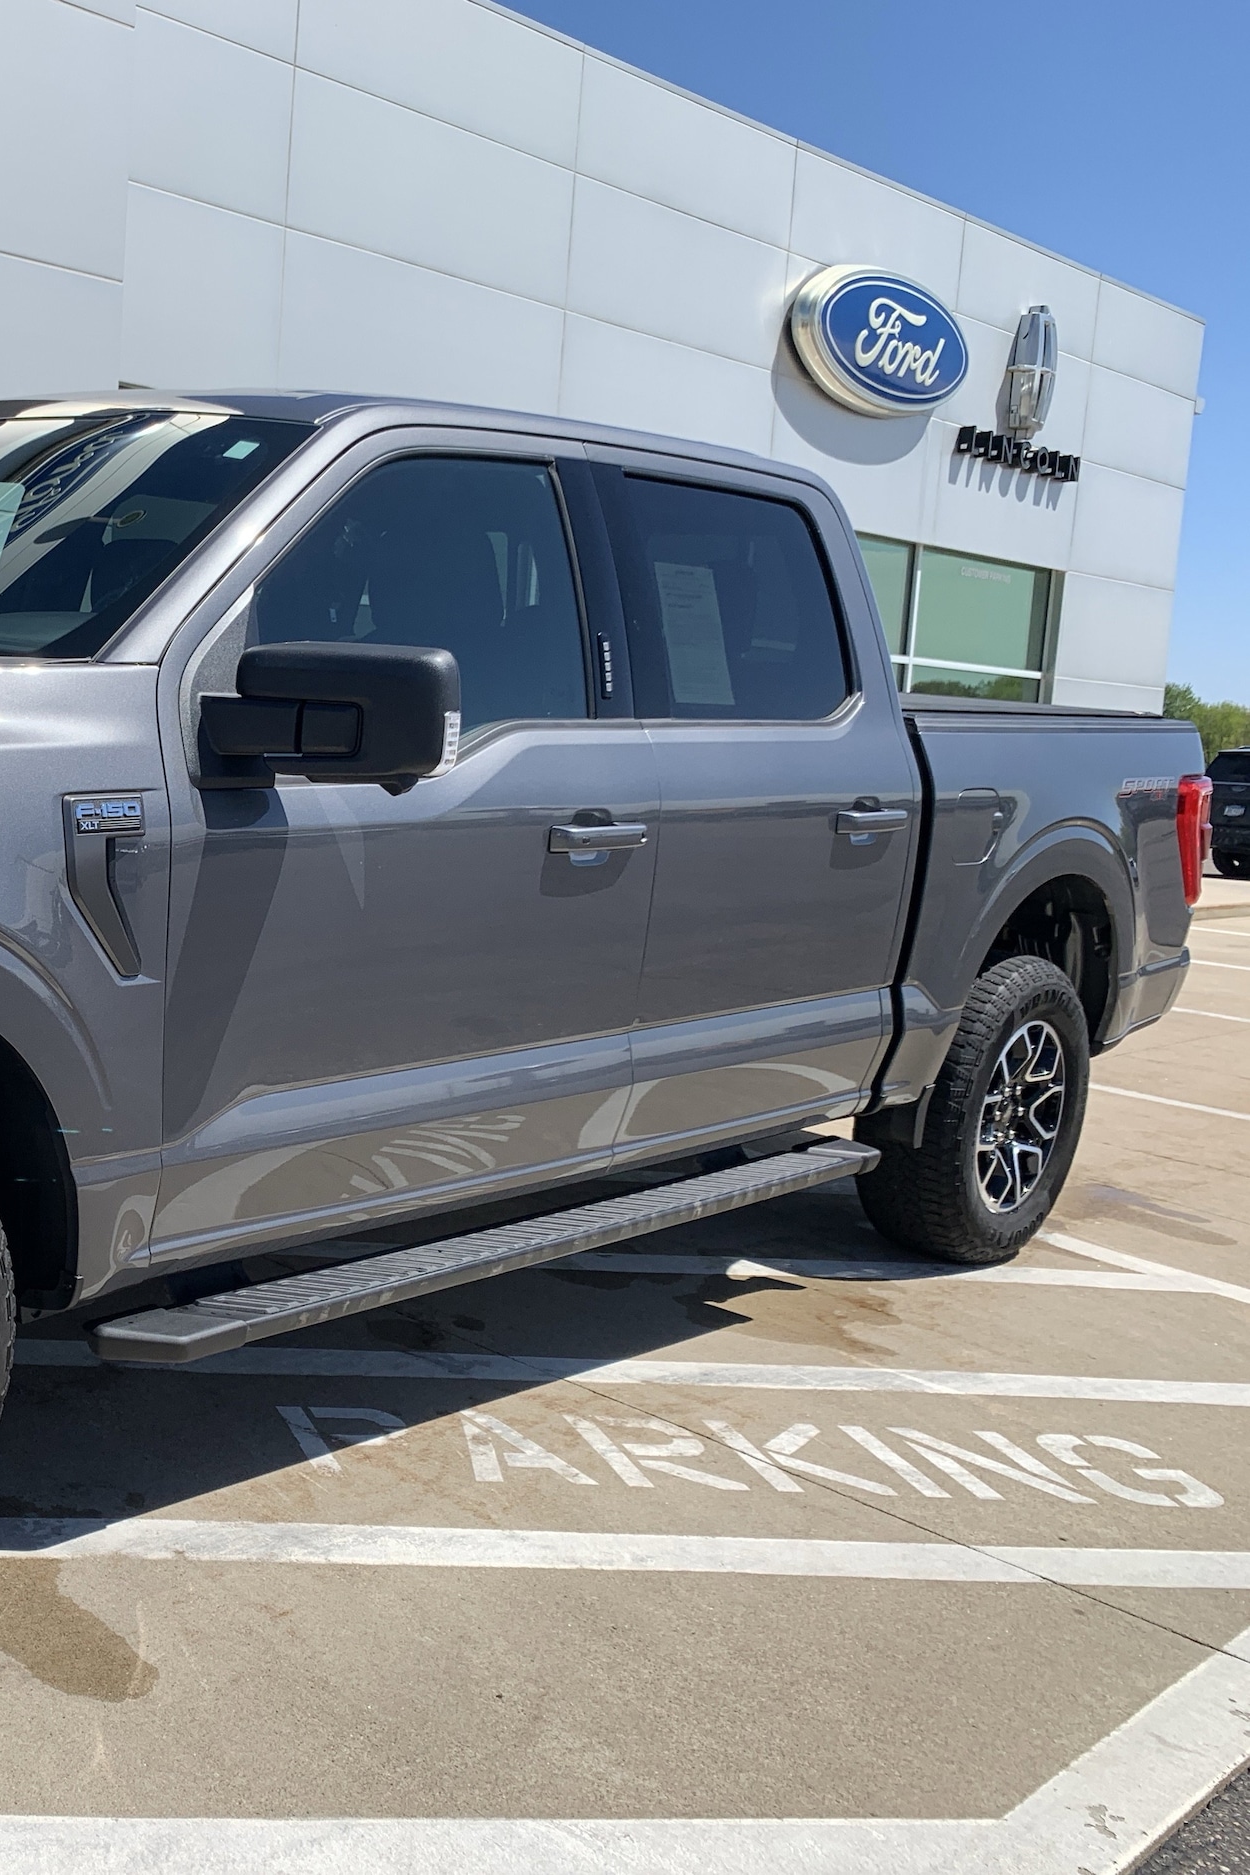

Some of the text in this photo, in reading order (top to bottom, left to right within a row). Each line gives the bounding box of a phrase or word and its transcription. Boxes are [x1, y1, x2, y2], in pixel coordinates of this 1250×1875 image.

[854, 297, 946, 387] Ford
[956, 425, 1082, 483] LINCOLN
[1118, 775, 1176, 799] SPORT
[75, 800, 142, 819] F-150
[80, 820, 100, 831] XLT
[275, 1404, 1226, 1509] PARKING
